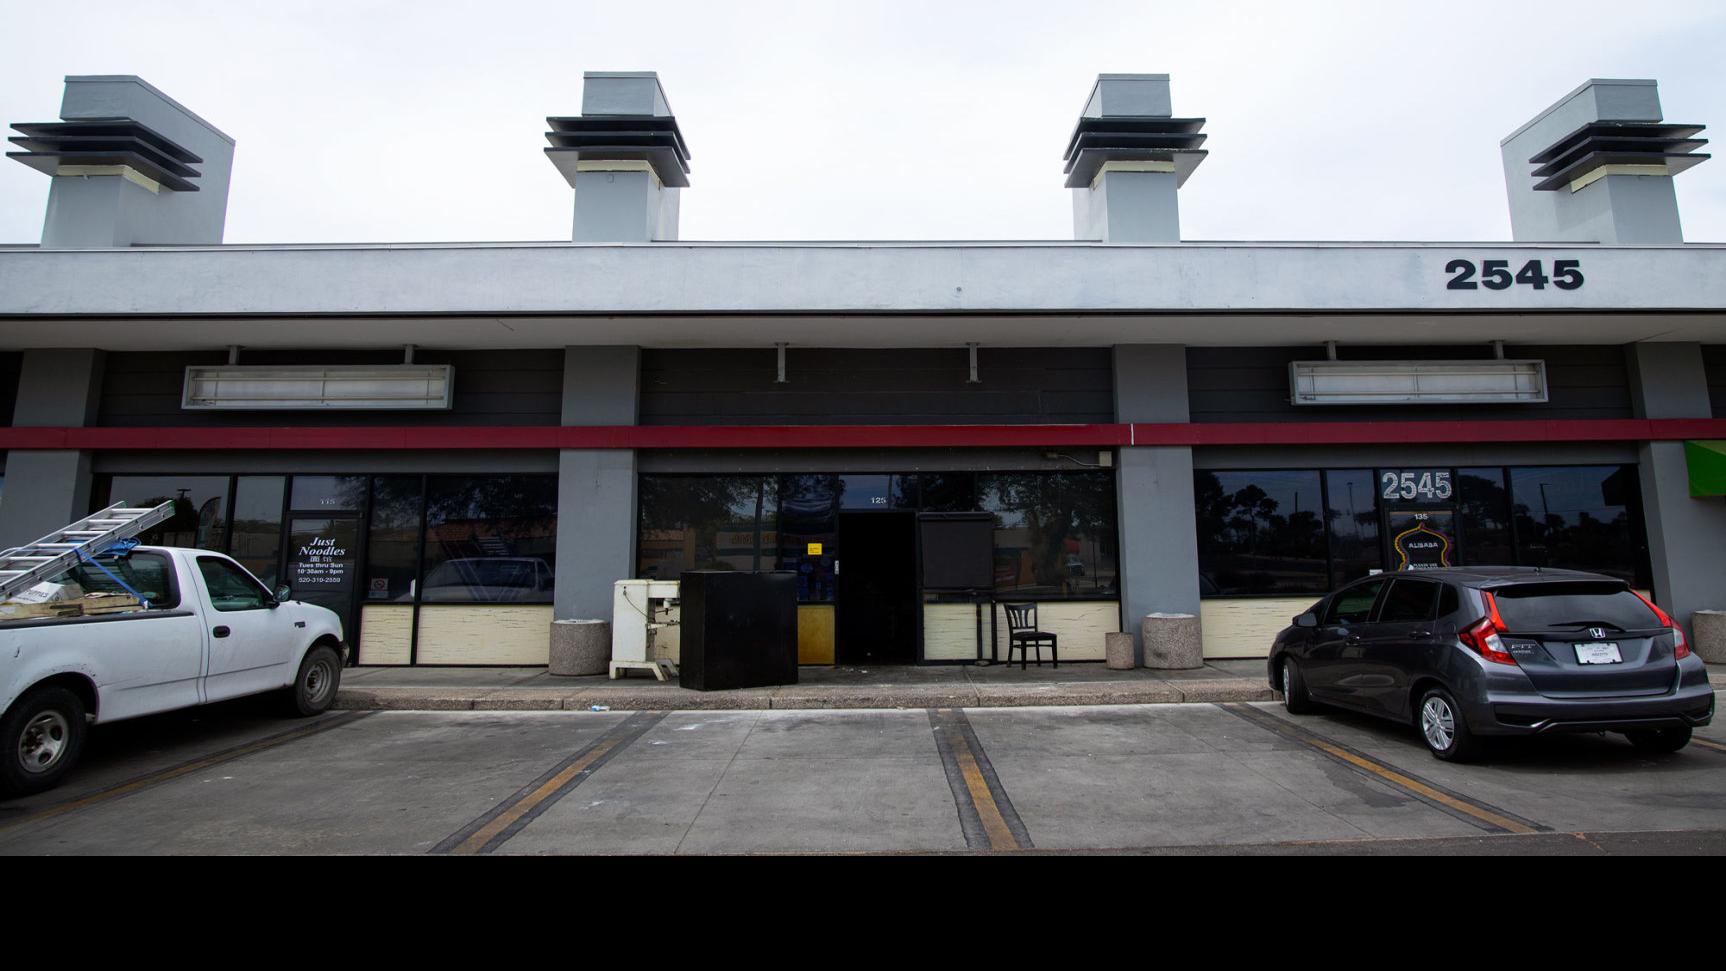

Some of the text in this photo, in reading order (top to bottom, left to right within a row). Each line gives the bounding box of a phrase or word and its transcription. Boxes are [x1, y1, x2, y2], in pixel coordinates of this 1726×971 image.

[1445, 259, 1585, 290] 2545
[1382, 472, 1452, 499] 2545
[871, 496, 887, 504] 125
[310, 537, 336, 546] Just
[298, 546, 346, 556] Noodles
